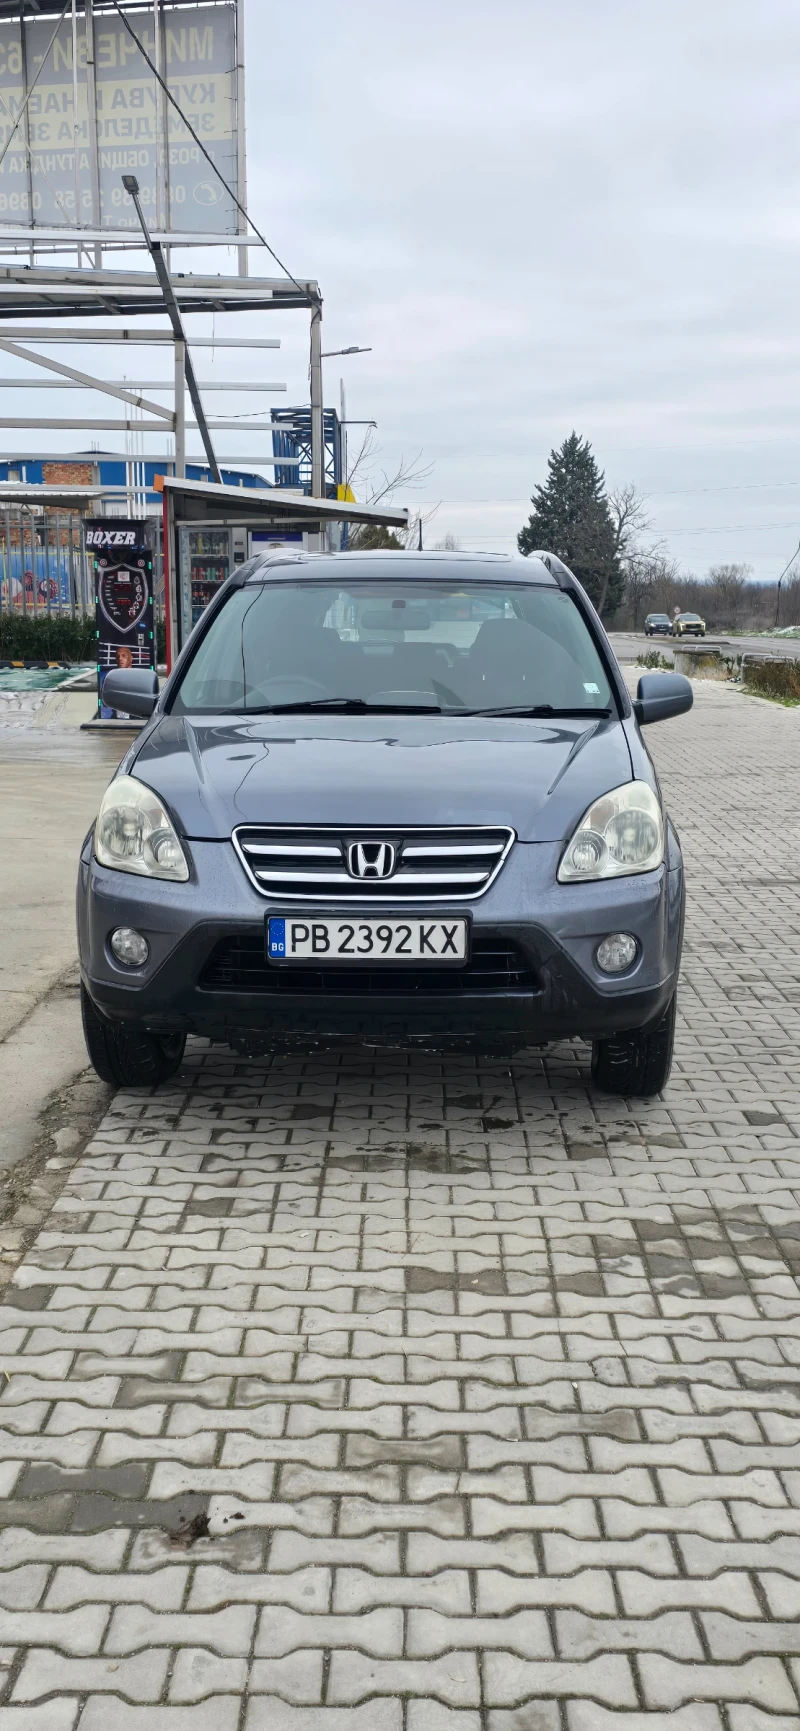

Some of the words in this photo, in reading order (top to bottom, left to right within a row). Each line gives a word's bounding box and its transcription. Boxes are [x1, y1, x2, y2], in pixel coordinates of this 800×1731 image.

[86, 531, 136, 545] BOXER
[338, 924, 412, 954] 2392
[271, 942, 284, 951] BG
